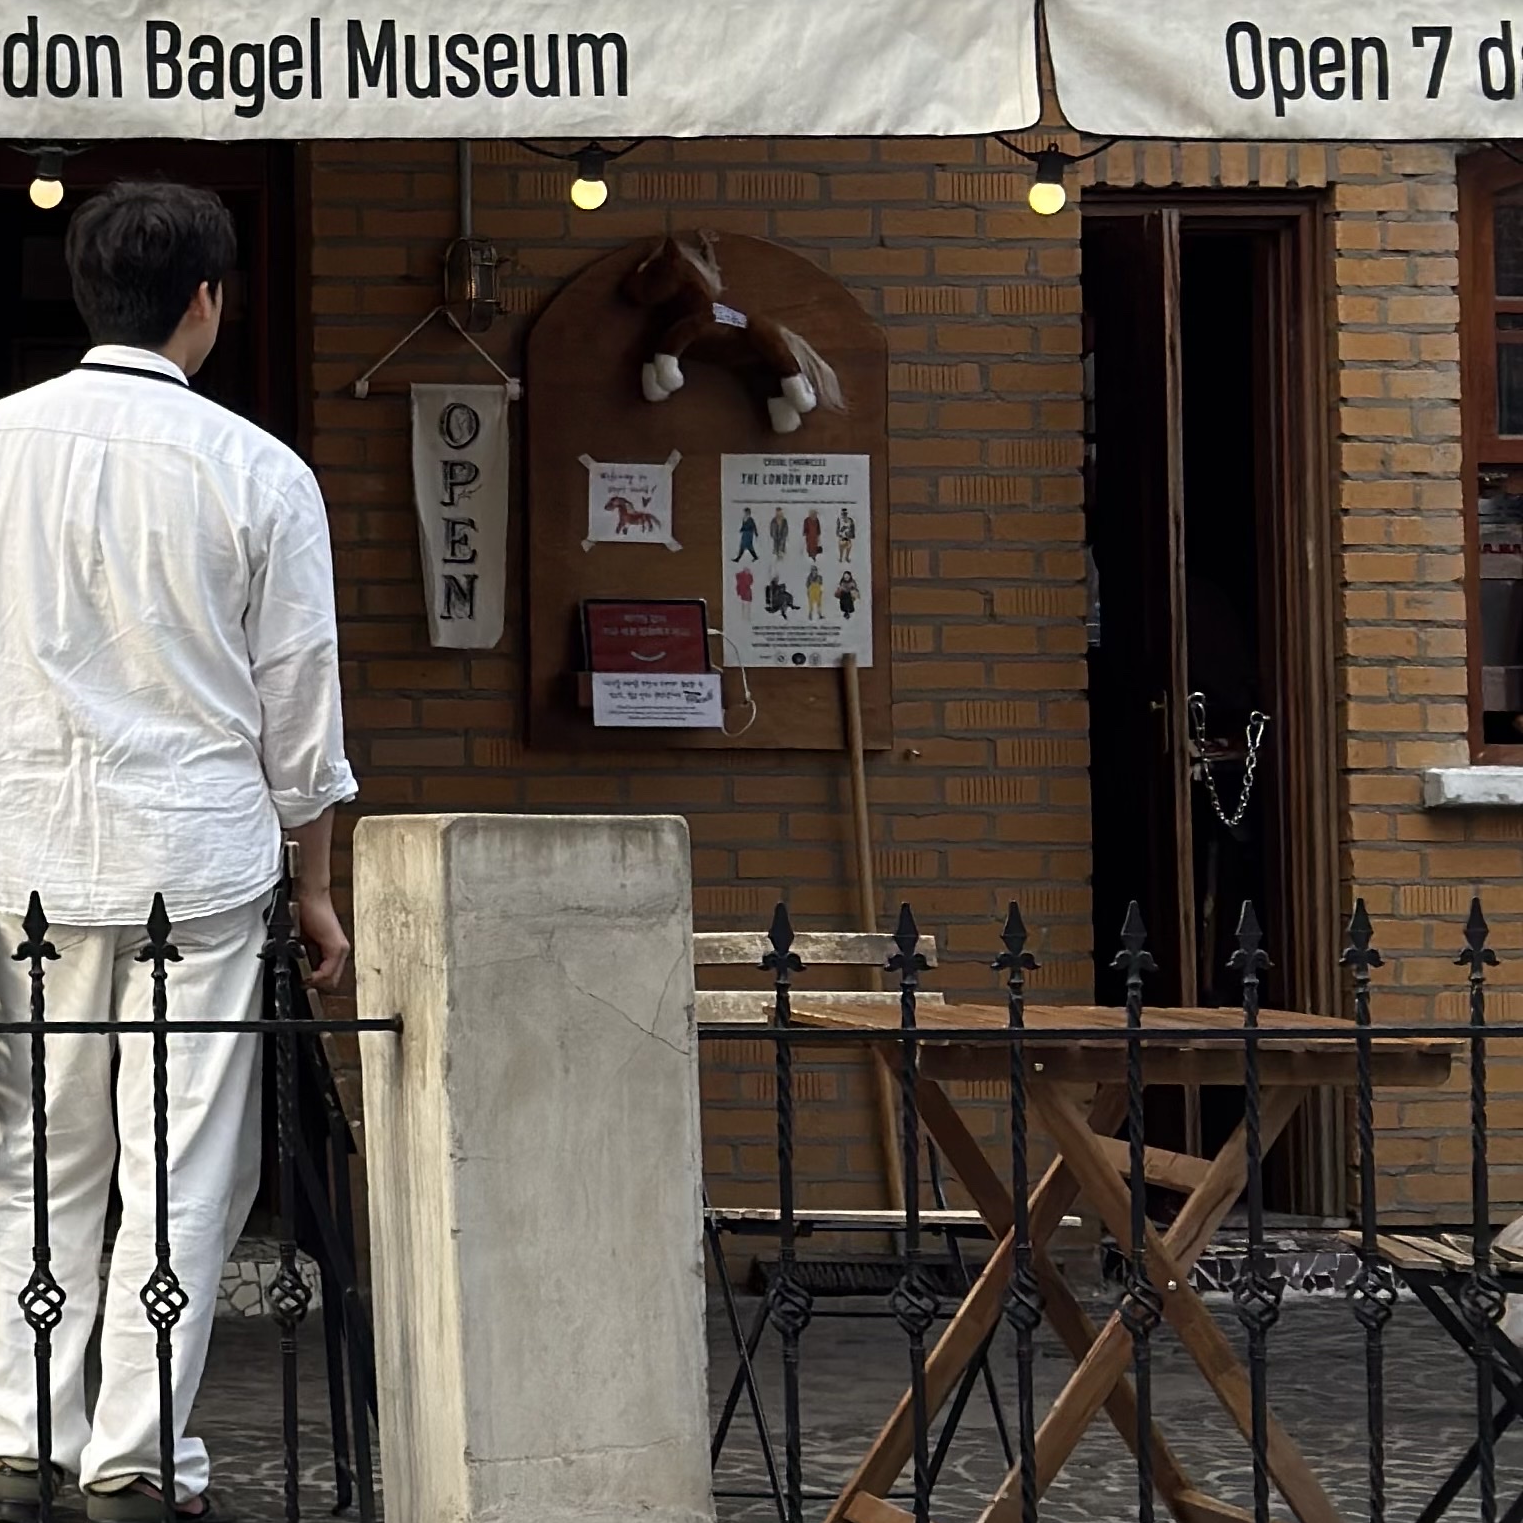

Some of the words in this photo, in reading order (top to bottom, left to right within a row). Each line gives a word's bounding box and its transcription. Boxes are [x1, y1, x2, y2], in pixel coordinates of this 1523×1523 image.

[145, 17, 322, 119] Bagel
[347, 19, 628, 99] Museum
[1225, 21, 1389, 118] Open
[1411, 26, 1453, 99] 7
[1478, 20, 1523, 101] d
[438, 402, 482, 620] OPEN
[741, 473, 759, 485] THE
[762, 473, 802, 486] LONDON
[804, 474, 850, 486] PROJECT
